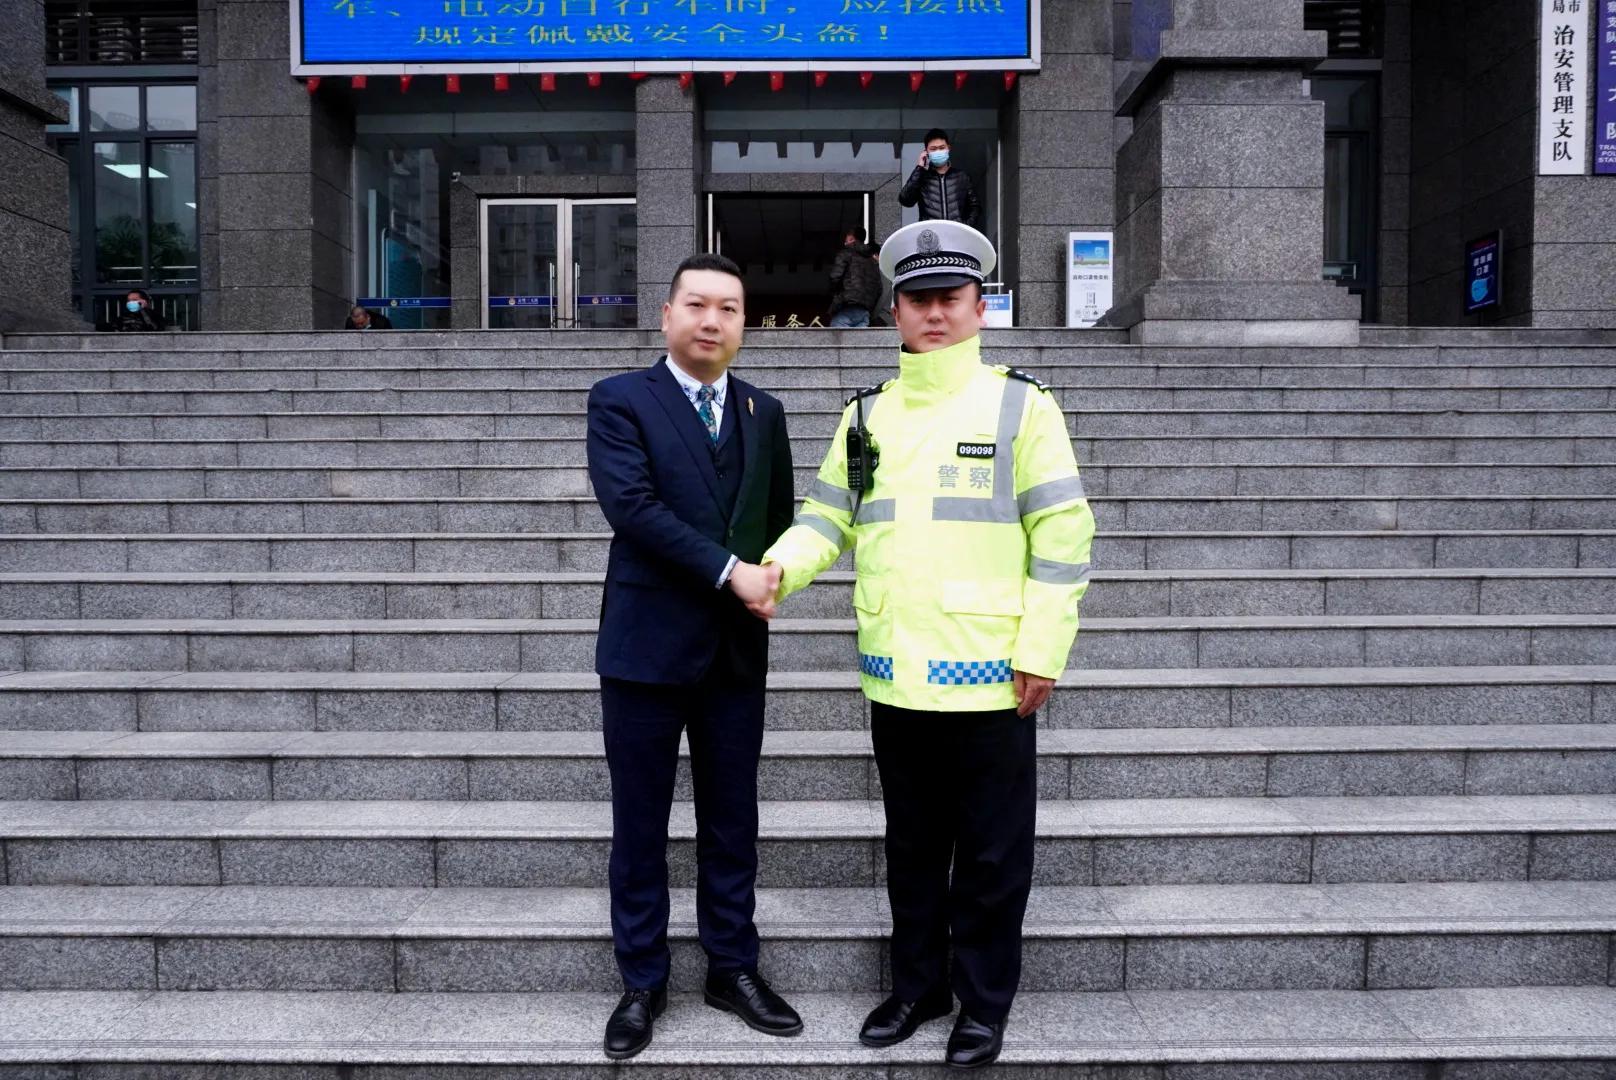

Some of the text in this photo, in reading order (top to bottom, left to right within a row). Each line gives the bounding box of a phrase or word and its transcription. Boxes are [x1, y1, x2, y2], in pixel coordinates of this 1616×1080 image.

[1552, 24, 1575, 161] 治安管理支队
[959, 445, 994, 455] 099098
[938, 464, 991, 489] 警察
